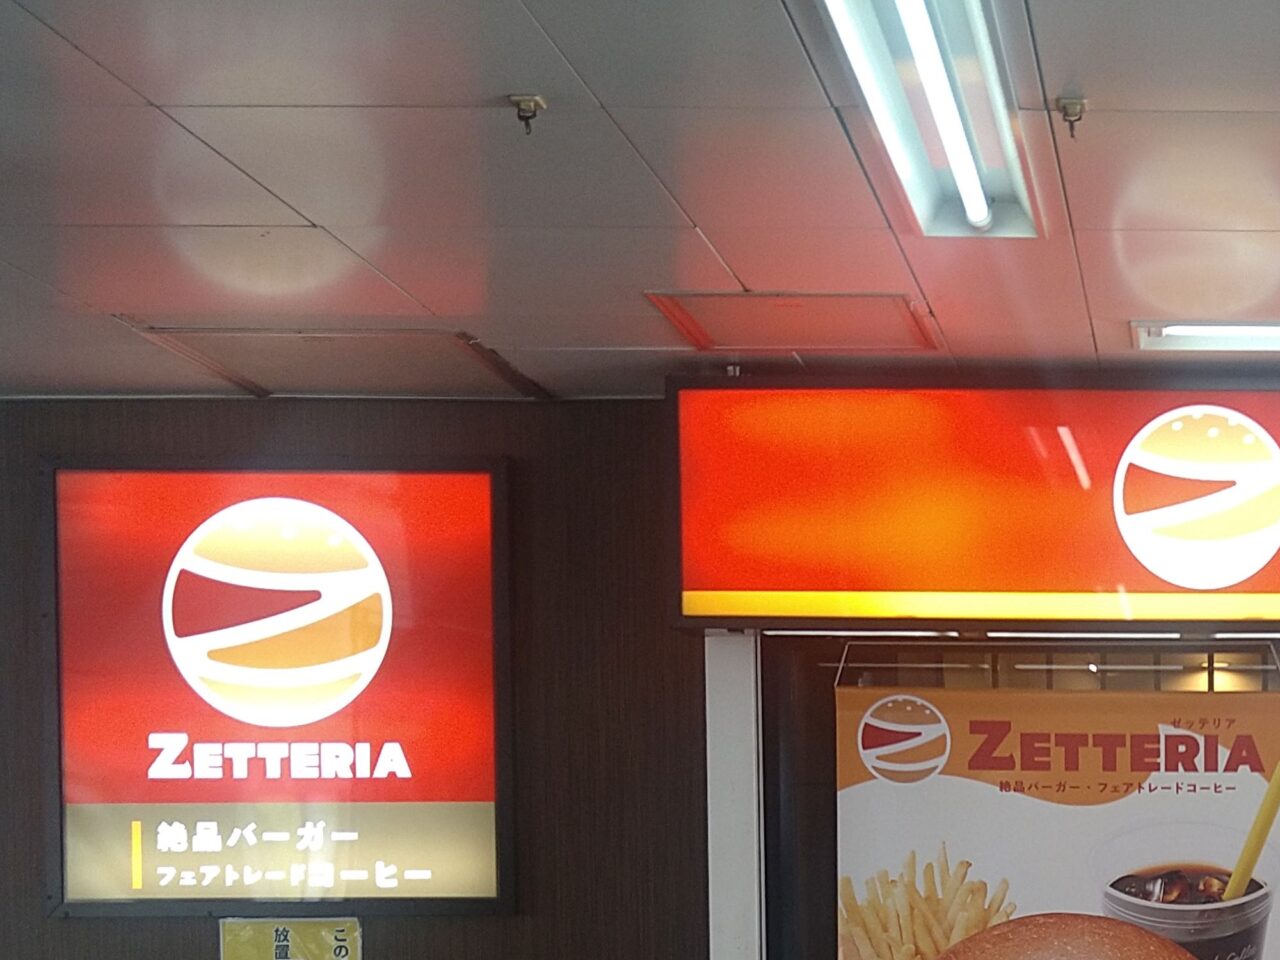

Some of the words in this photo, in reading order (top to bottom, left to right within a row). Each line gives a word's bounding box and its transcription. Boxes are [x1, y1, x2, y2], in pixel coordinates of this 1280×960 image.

[1169, 718, 1237, 731] ゼッテリア
[147, 733, 412, 779] ZETTERIA
[967, 720, 1266, 773] ZETTERIA
[156, 820, 359, 852] 絶品バーガー
[156, 860, 432, 888] フェアトレードコーヒー
